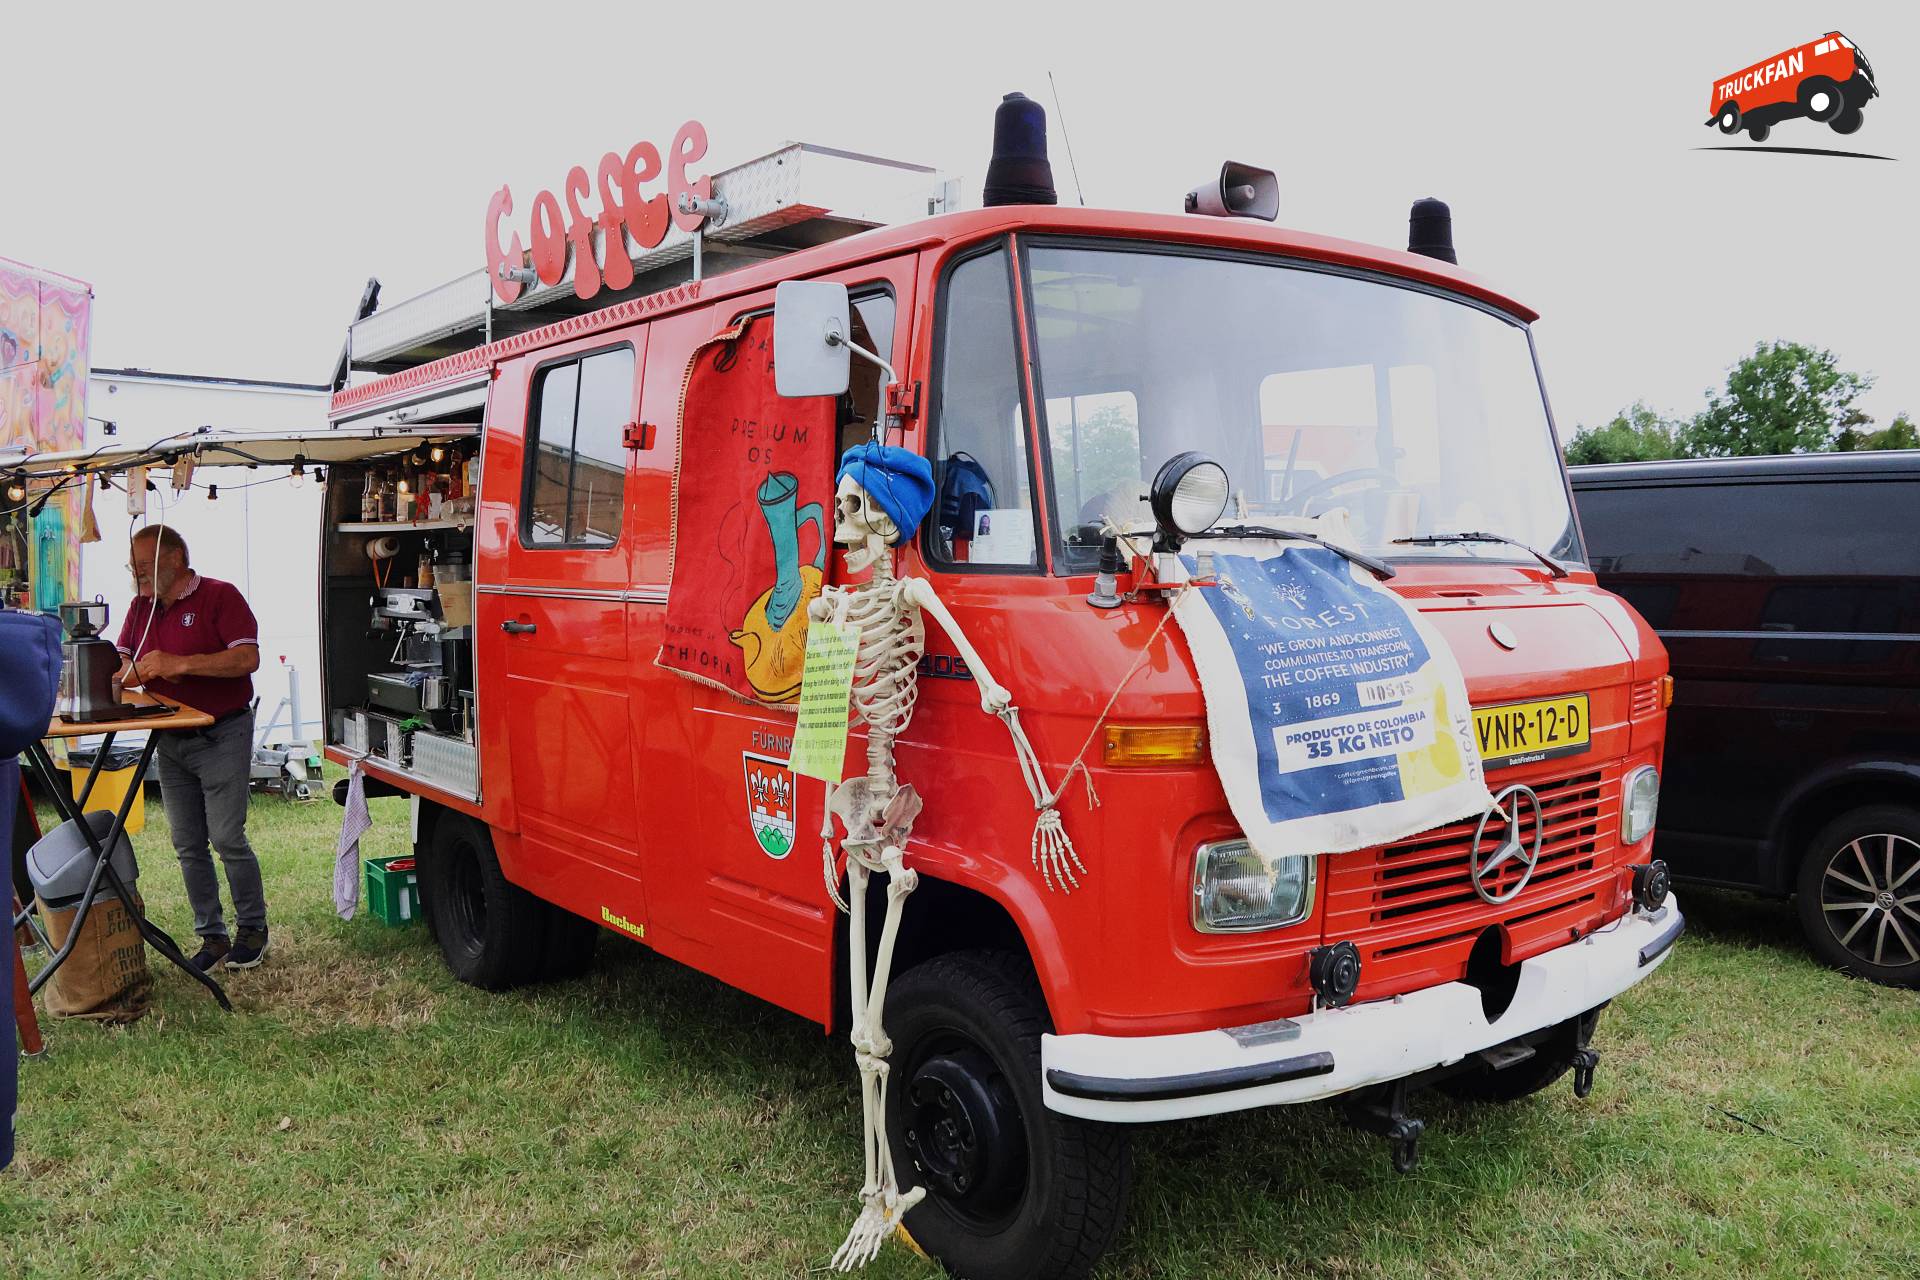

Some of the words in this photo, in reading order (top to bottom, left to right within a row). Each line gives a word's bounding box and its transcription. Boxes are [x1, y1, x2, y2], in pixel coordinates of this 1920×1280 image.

[485, 120, 711, 304] Coffee
[1262, 603, 1369, 629] FOREST
[1288, 638, 1326, 650] GROW
[1329, 634, 1354, 647] AND
[1354, 627, 1403, 643] CONNECT
[1264, 652, 1341, 671] COMMUNITIES
[1342, 650, 1354, 660] TO
[1355, 641, 1408, 658] TRANSFORM
[1261, 671, 1293, 689] THE
[1294, 664, 1350, 683] COFFEE
[1272, 702, 1282, 715] 3
[1305, 692, 1341, 709] 1869
[752, 725, 792, 754] FÜRNR
[1286, 724, 1355, 745] PRODUCTO
[1357, 721, 1372, 733] DE
[1374, 710, 1426, 730] COLOMBIA
[1477, 704, 1580, 753] VNR-12-D
[1306, 740, 1333, 759] 35
[1339, 734, 1366, 754] KG
[1370, 726, 1415, 749] NETO
